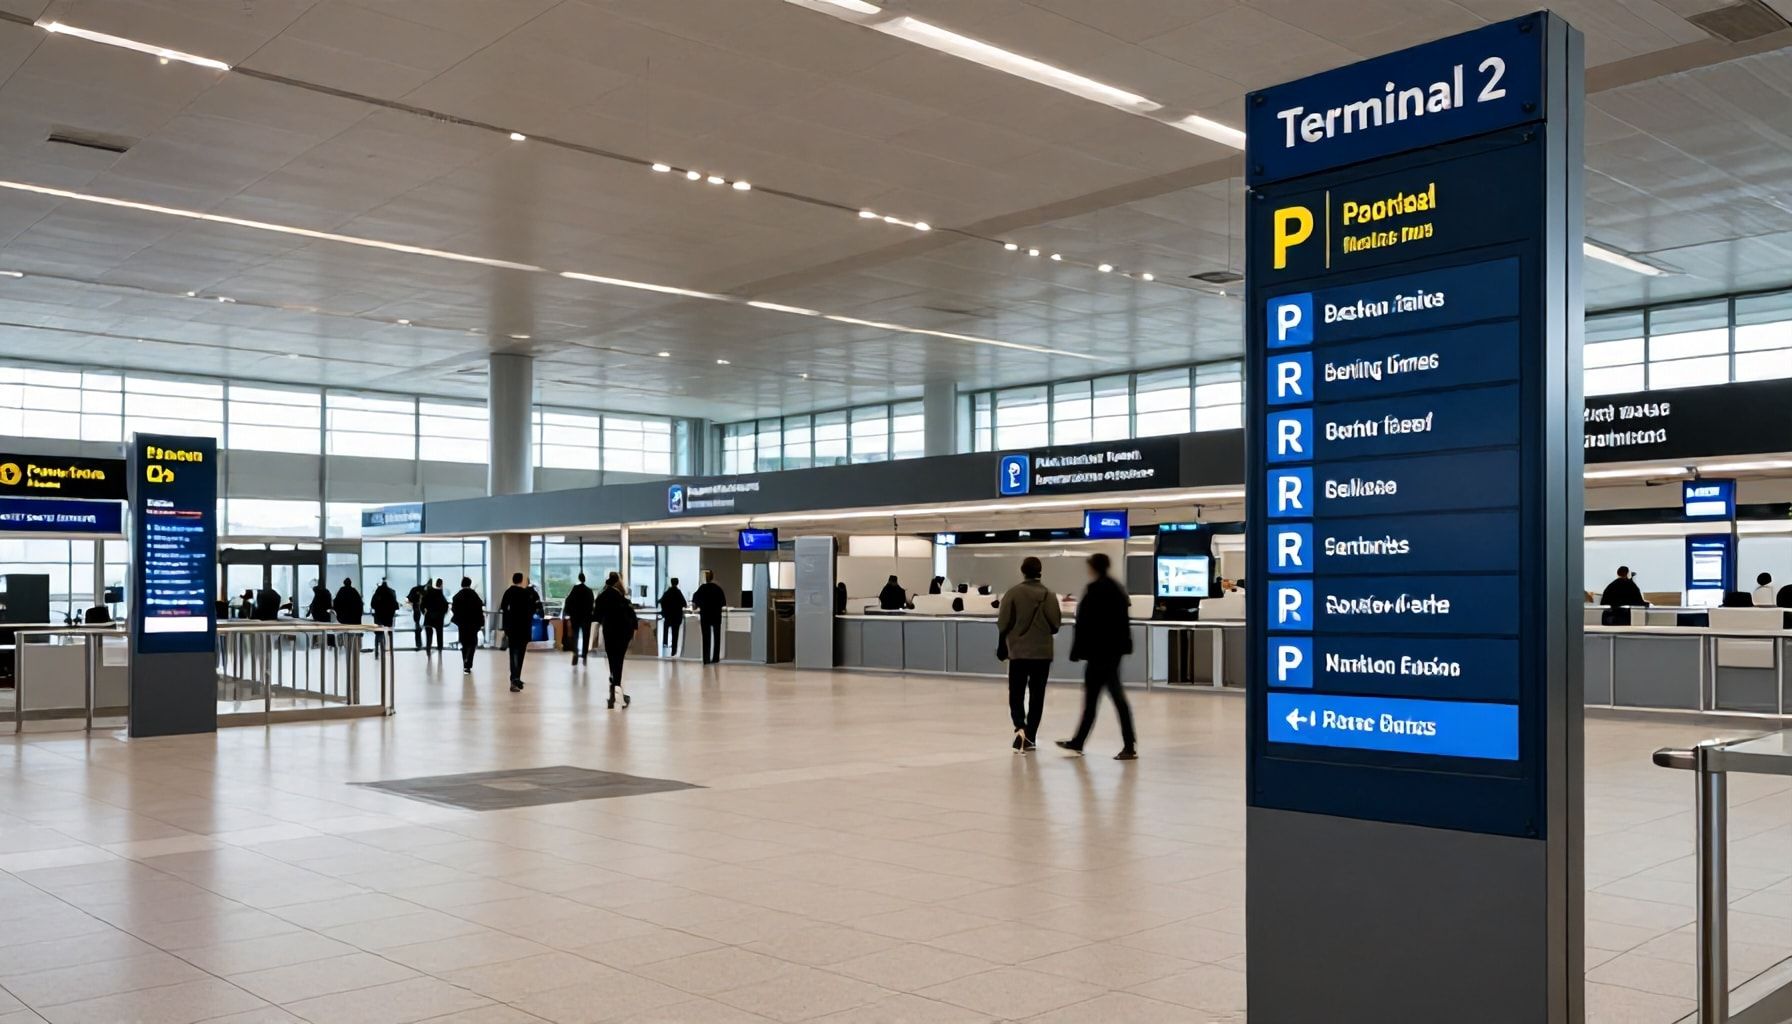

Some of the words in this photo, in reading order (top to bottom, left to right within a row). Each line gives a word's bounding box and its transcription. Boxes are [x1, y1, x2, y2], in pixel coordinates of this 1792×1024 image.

[1277, 63, 1463, 148] Terminal
[1478, 56, 1506, 102] 2
[1273, 206, 1314, 269] P
[1277, 304, 1302, 341] P
[1277, 361, 1303, 398] R
[1278, 419, 1303, 455] R
[1278, 476, 1303, 512] R
[1278, 531, 1303, 567] R
[1278, 588, 1302, 624] R
[1278, 645, 1303, 681] P
